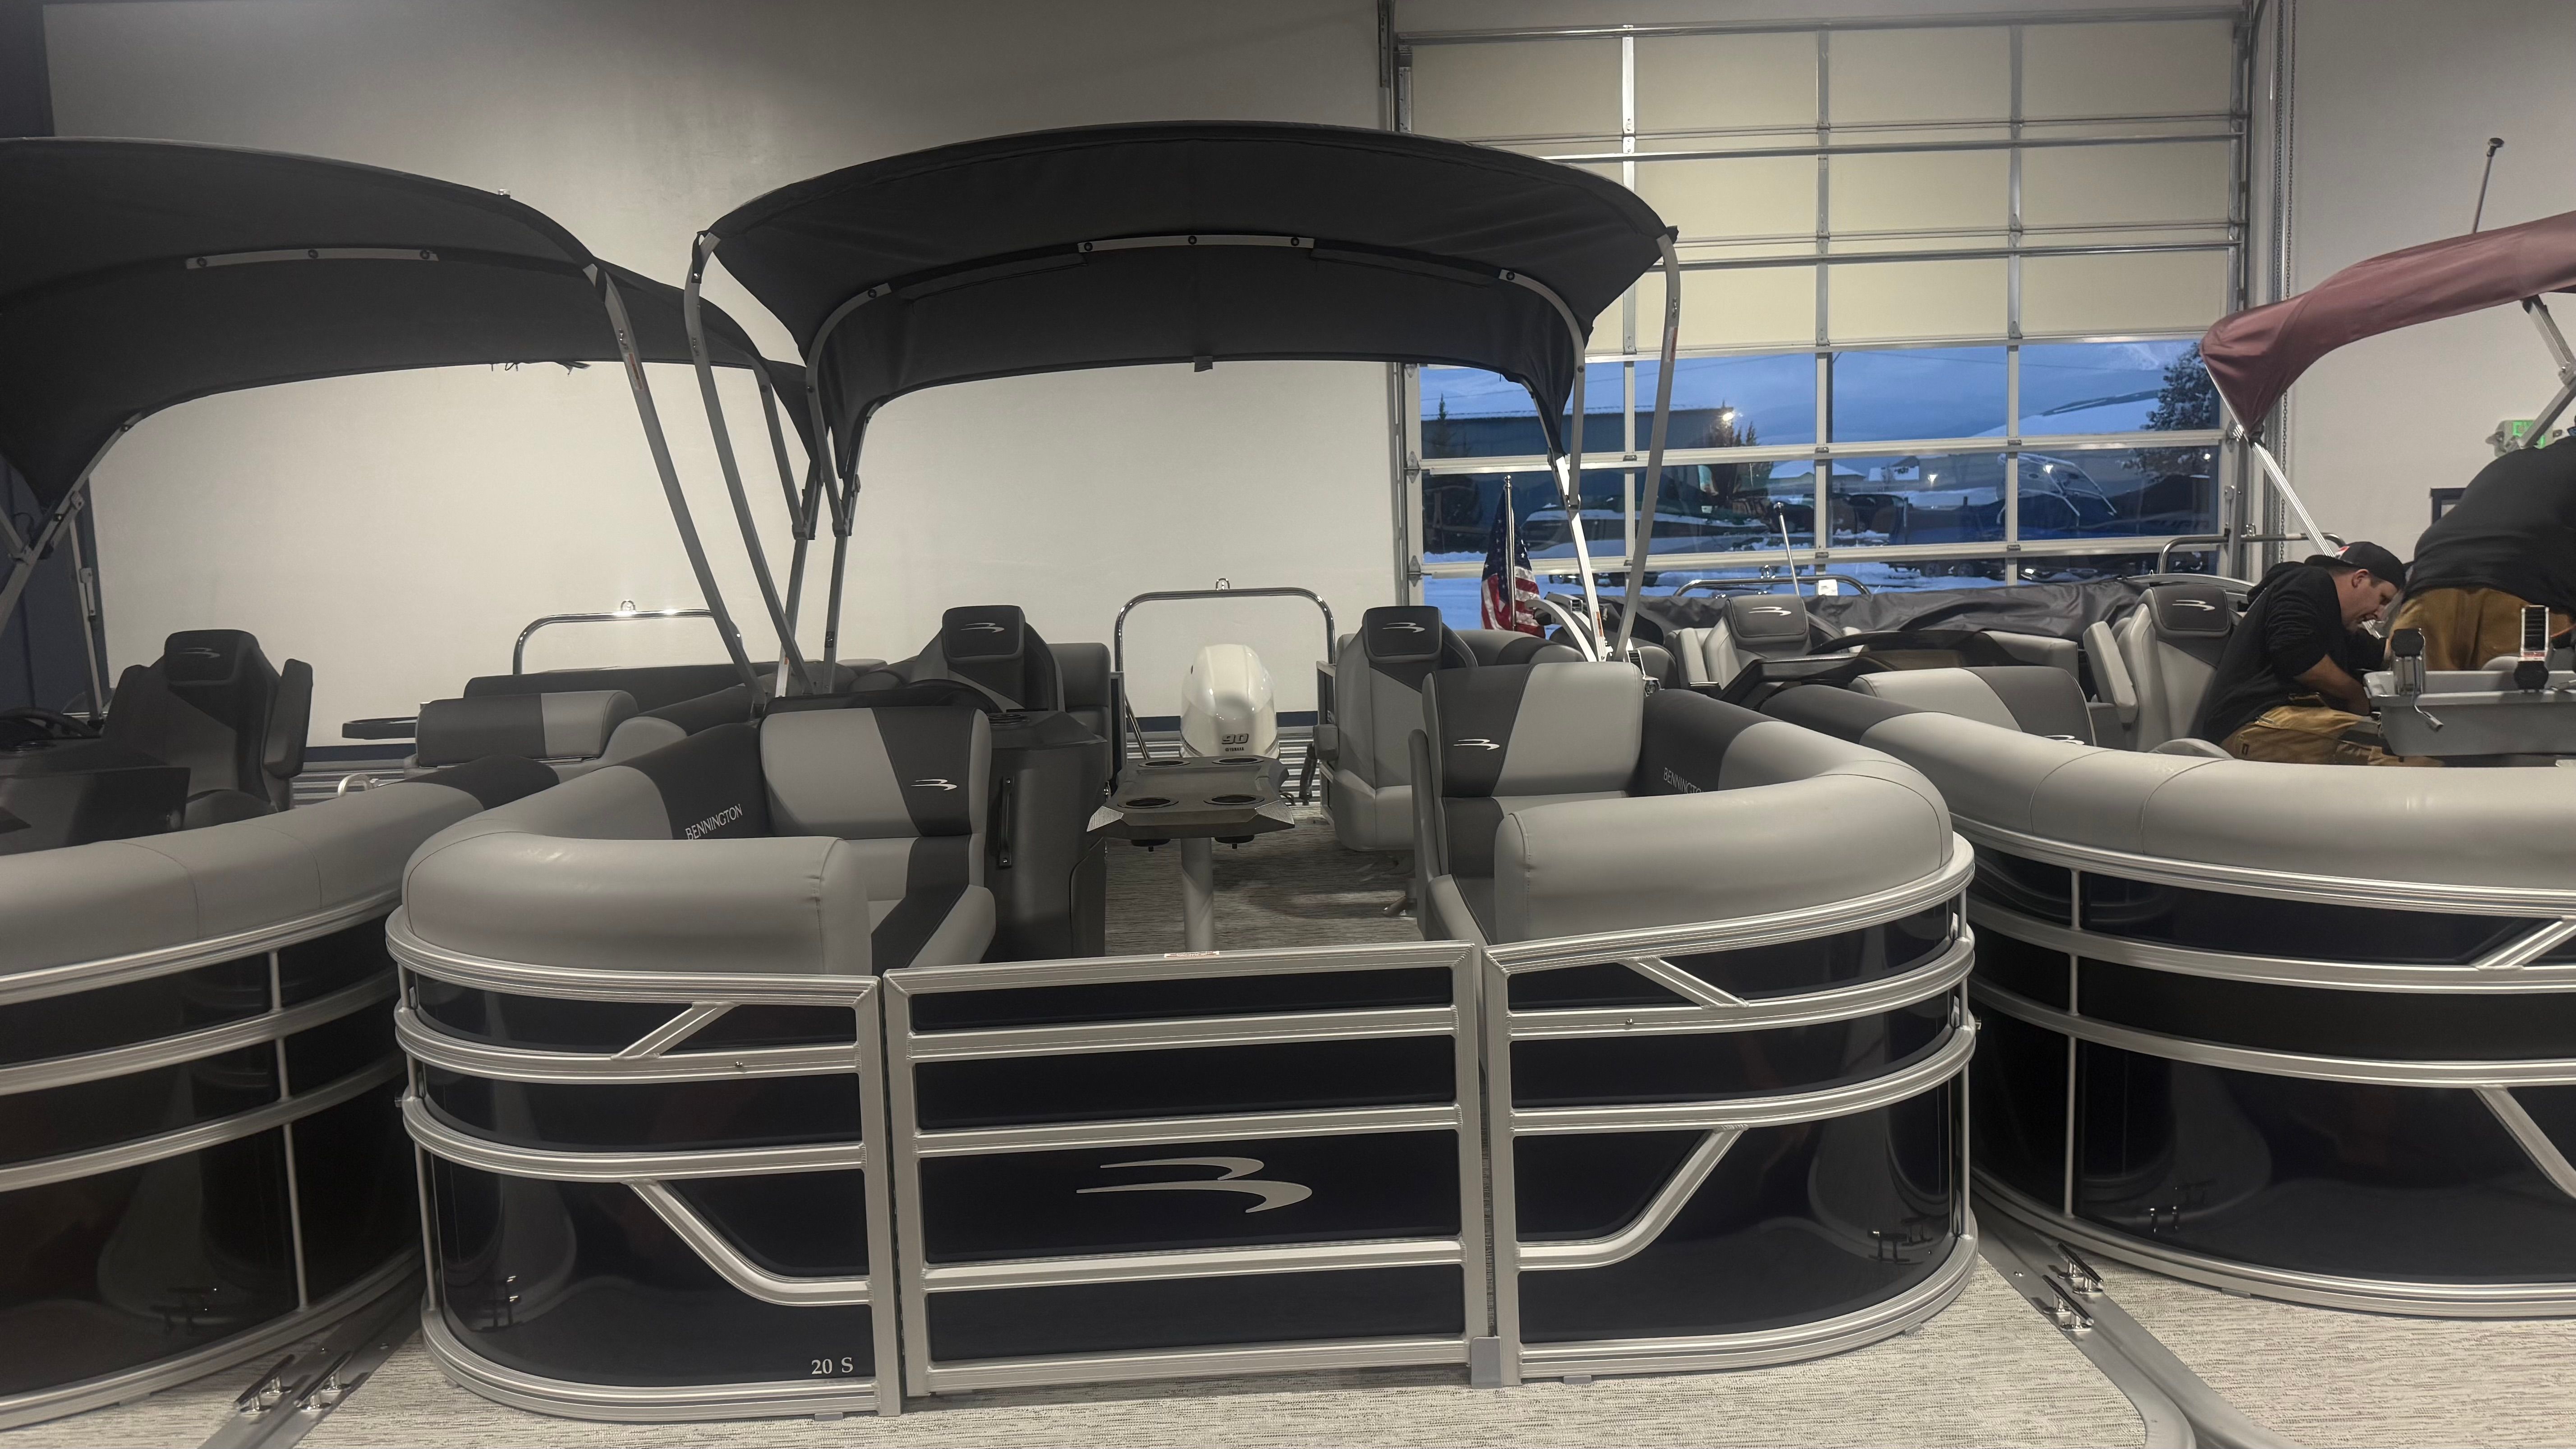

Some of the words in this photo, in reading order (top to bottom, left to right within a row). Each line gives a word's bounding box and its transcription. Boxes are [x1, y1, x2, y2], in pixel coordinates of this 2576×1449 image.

[1222, 733, 1249, 744] 90
[685, 804, 743, 840] BENNINGTON
[811, 1359, 833, 1375] 20
[841, 1357, 853, 1373] S
